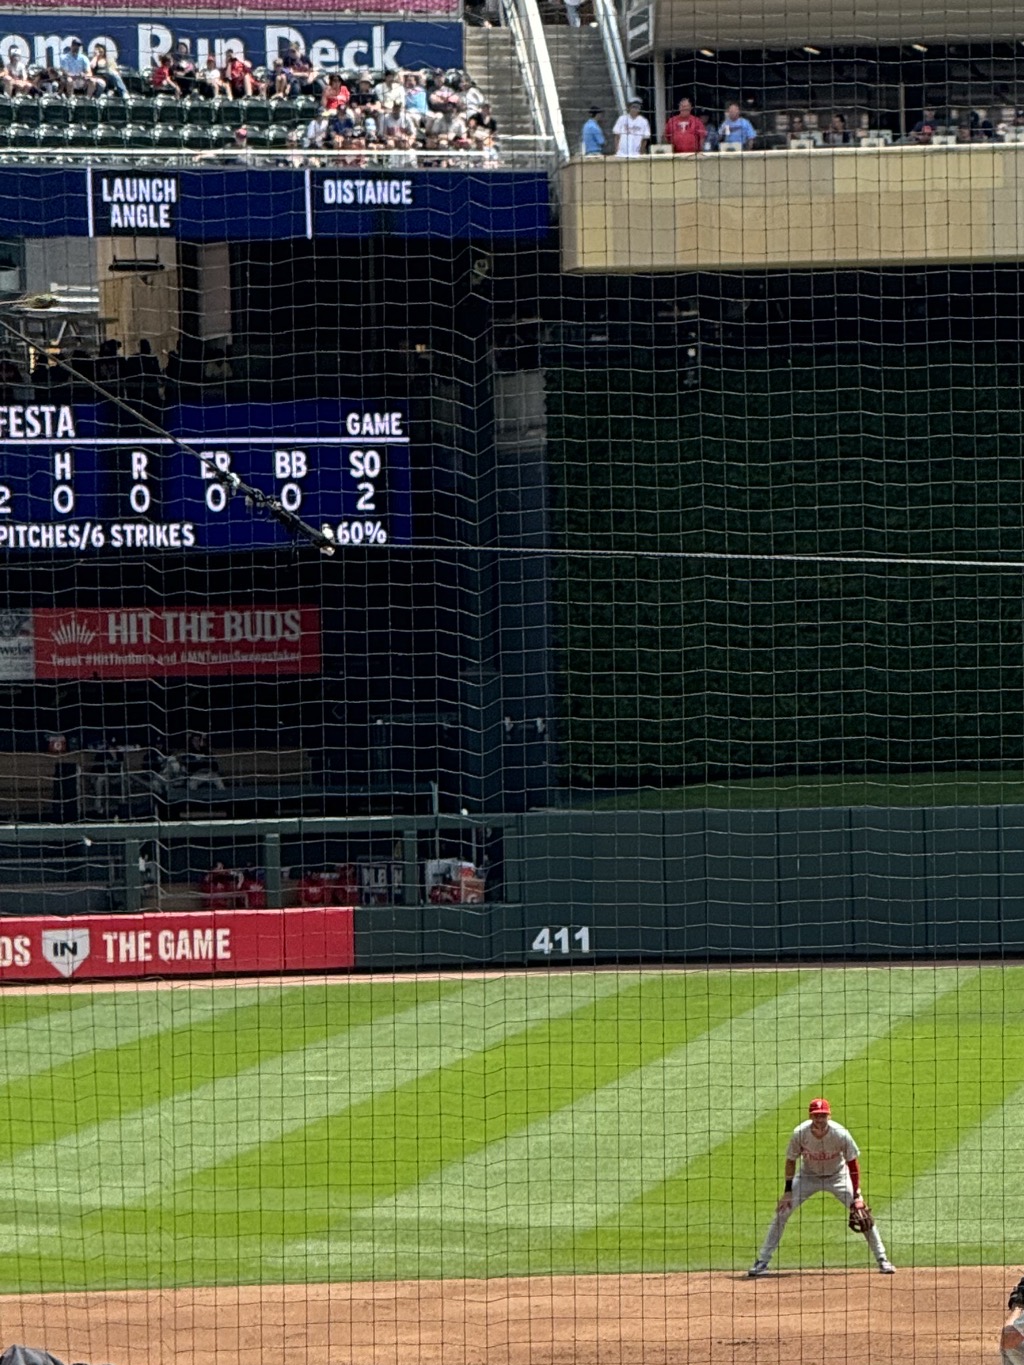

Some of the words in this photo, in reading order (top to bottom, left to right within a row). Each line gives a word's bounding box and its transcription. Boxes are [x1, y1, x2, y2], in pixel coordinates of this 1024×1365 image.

[138, 23, 245, 74] Run
[265, 25, 402, 73] Deck
[101, 177, 177, 204] LAUNCH
[323, 180, 414, 205] DISTANCE
[110, 204, 171, 229] ANGLE
[345, 412, 403, 436] GAME
[54, 452, 72, 480] H
[131, 452, 148, 480] R
[201, 451, 231, 480] ER
[275, 450, 307, 479] BB
[349, 450, 381, 478] SO
[53, 485, 75, 514] 0
[130, 484, 151, 513] 0
[205, 483, 227, 513] 0
[281, 482, 302, 512] 0
[356, 482, 376, 511] 2
[110, 523, 196, 548] STRIKES
[336, 521, 388, 545] 60%
[107, 611, 154, 644] HIT
[161, 611, 216, 644] THE
[223, 609, 301, 642] BUDS
[52, 941, 78, 957] IN
[102, 930, 153, 963] THE
[158, 928, 232, 962] GAME
[532, 926, 590, 955] 411
